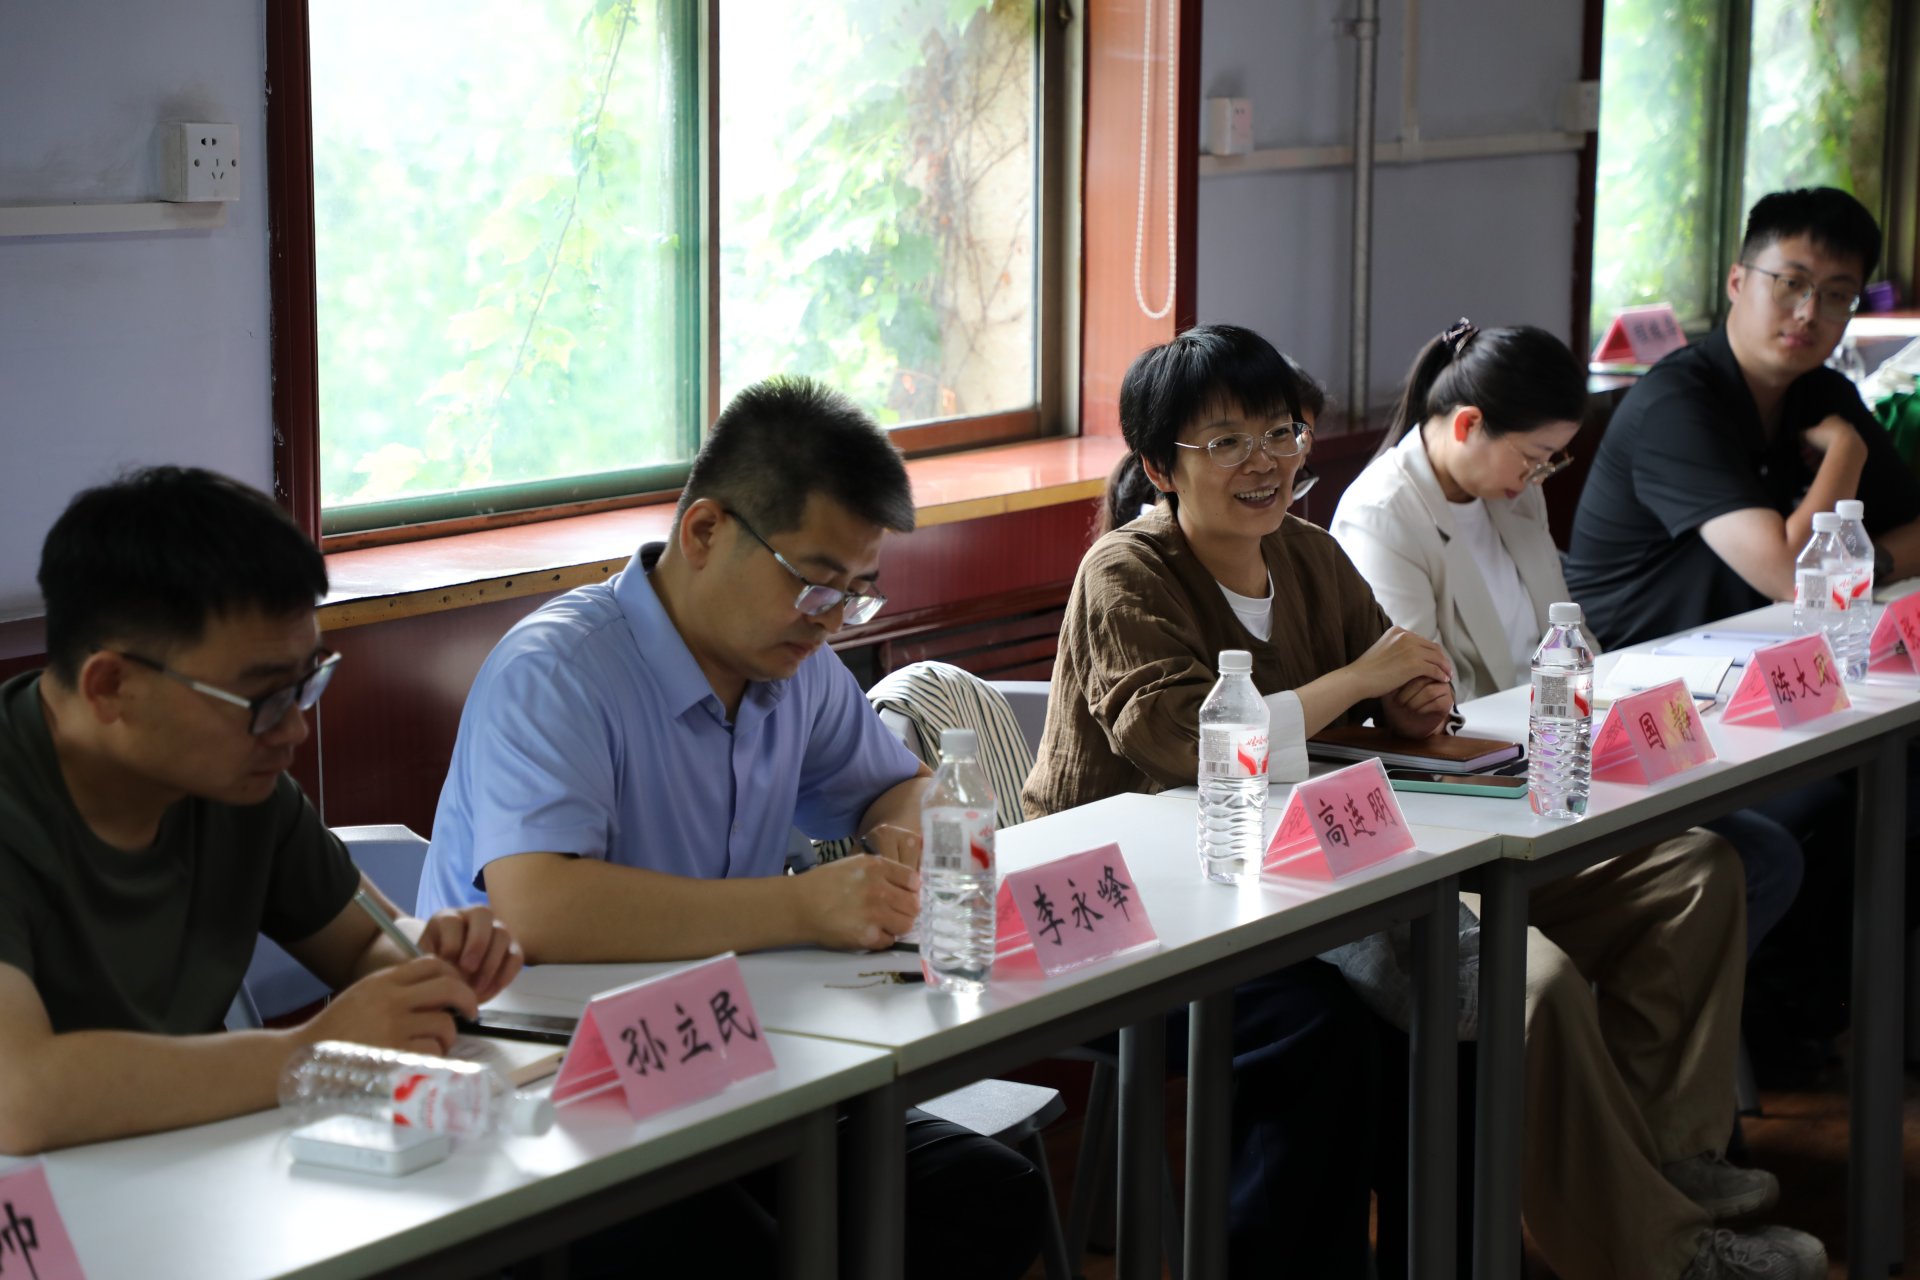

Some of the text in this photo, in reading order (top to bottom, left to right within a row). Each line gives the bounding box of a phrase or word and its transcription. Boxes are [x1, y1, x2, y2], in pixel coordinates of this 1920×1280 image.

[1032, 865, 1131, 946] 李永峰
[620, 990, 758, 1077] 孙立民
